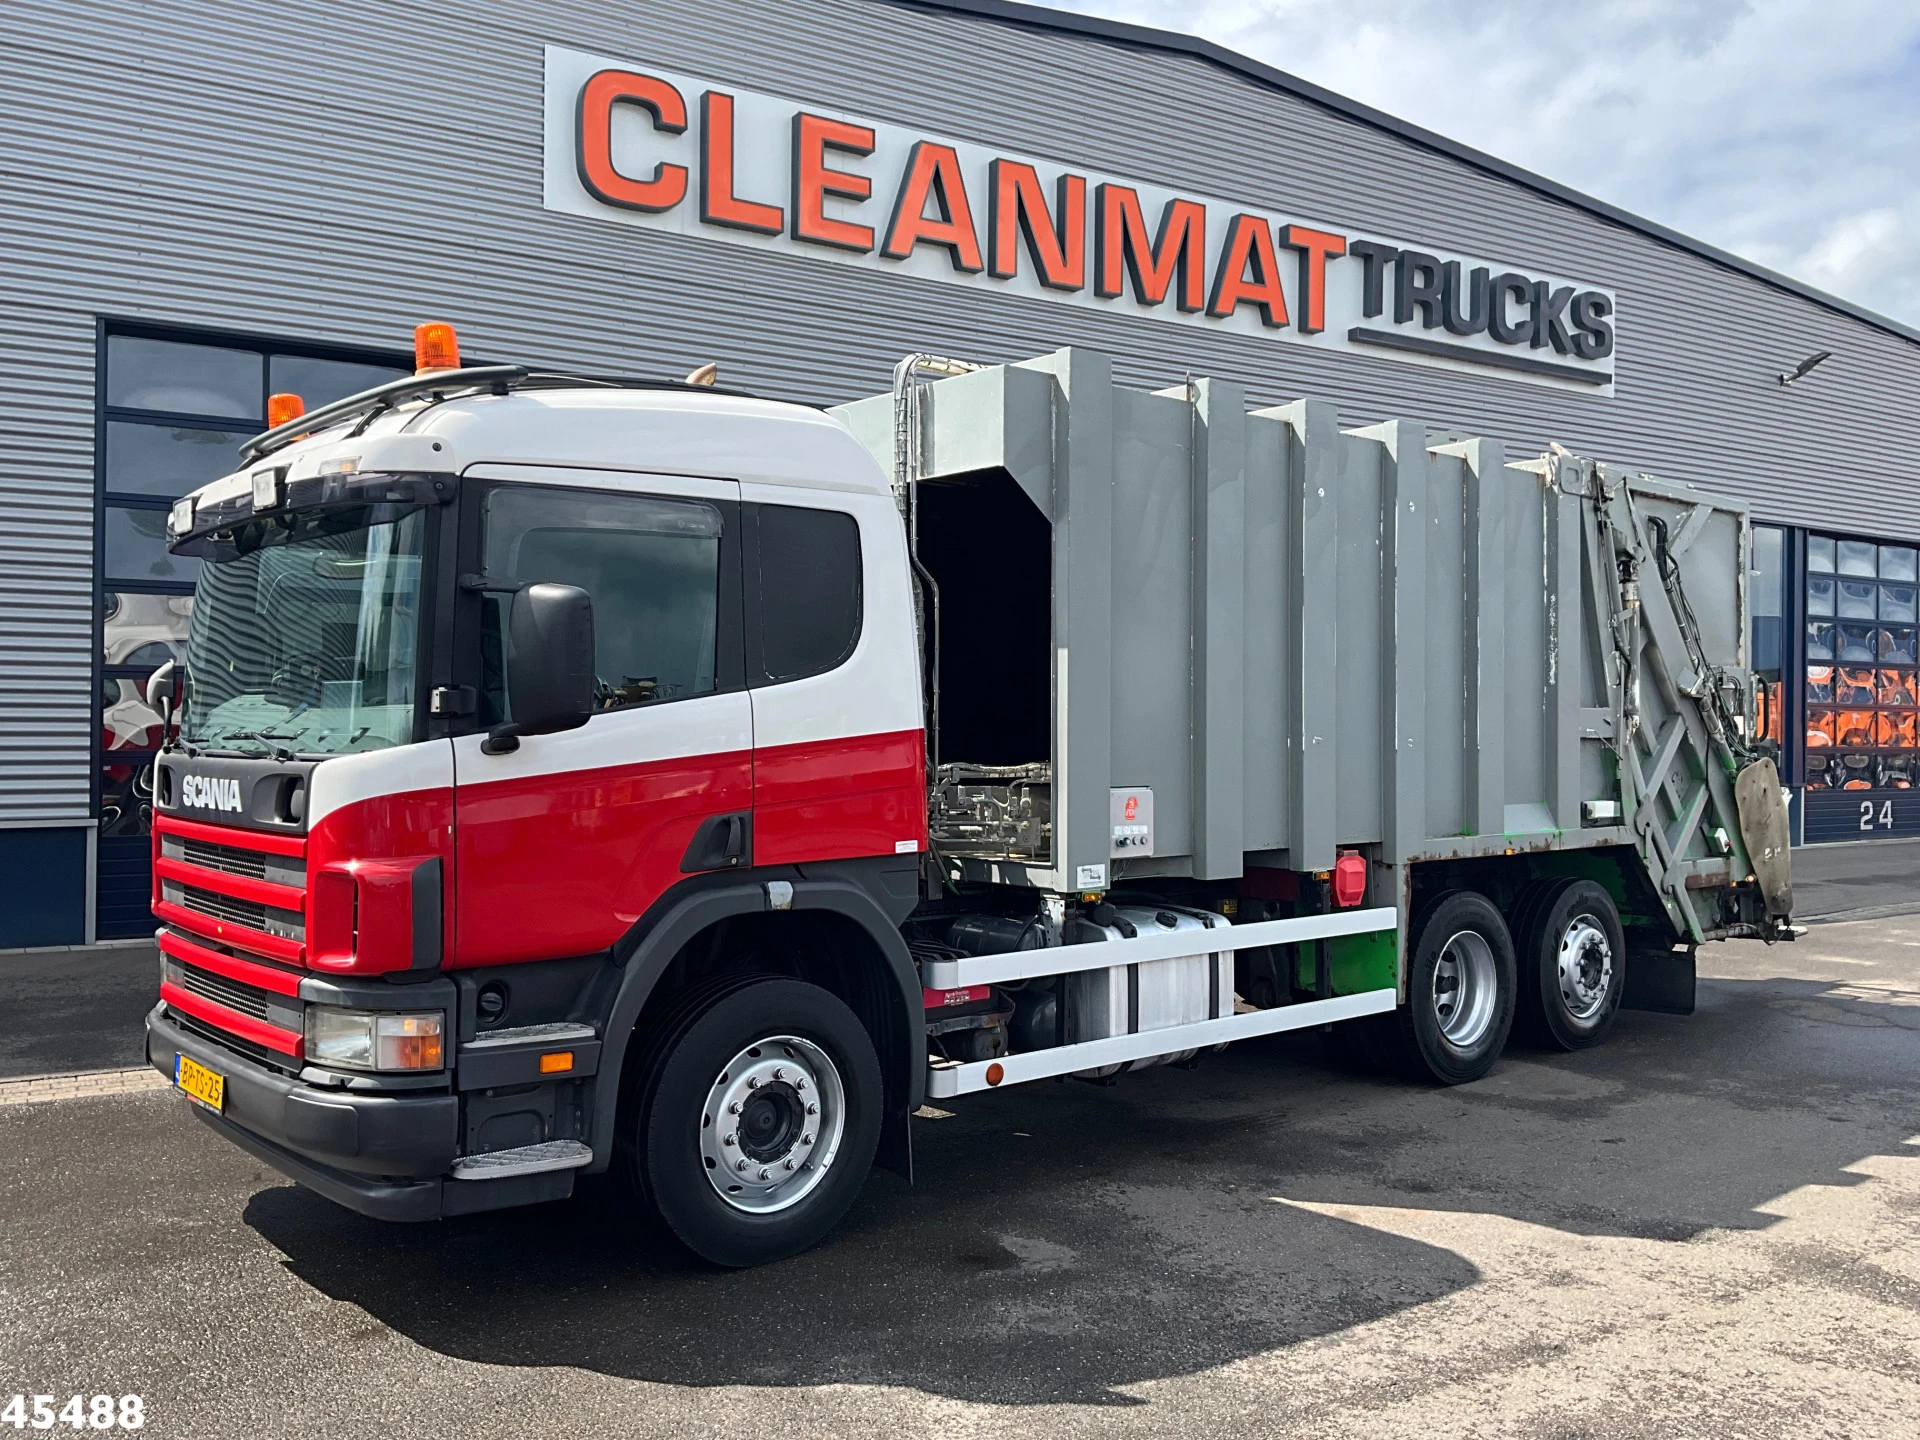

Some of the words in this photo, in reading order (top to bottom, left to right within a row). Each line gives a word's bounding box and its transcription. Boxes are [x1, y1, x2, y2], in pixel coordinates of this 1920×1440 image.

[575, 68, 1346, 334] CLEANMAT
[1349, 239, 1613, 361] TRUCKS
[182, 774, 243, 813] SCANIA
[1860, 800, 1893, 830] 24
[182, 1061, 220, 1103] BP-TS-25
